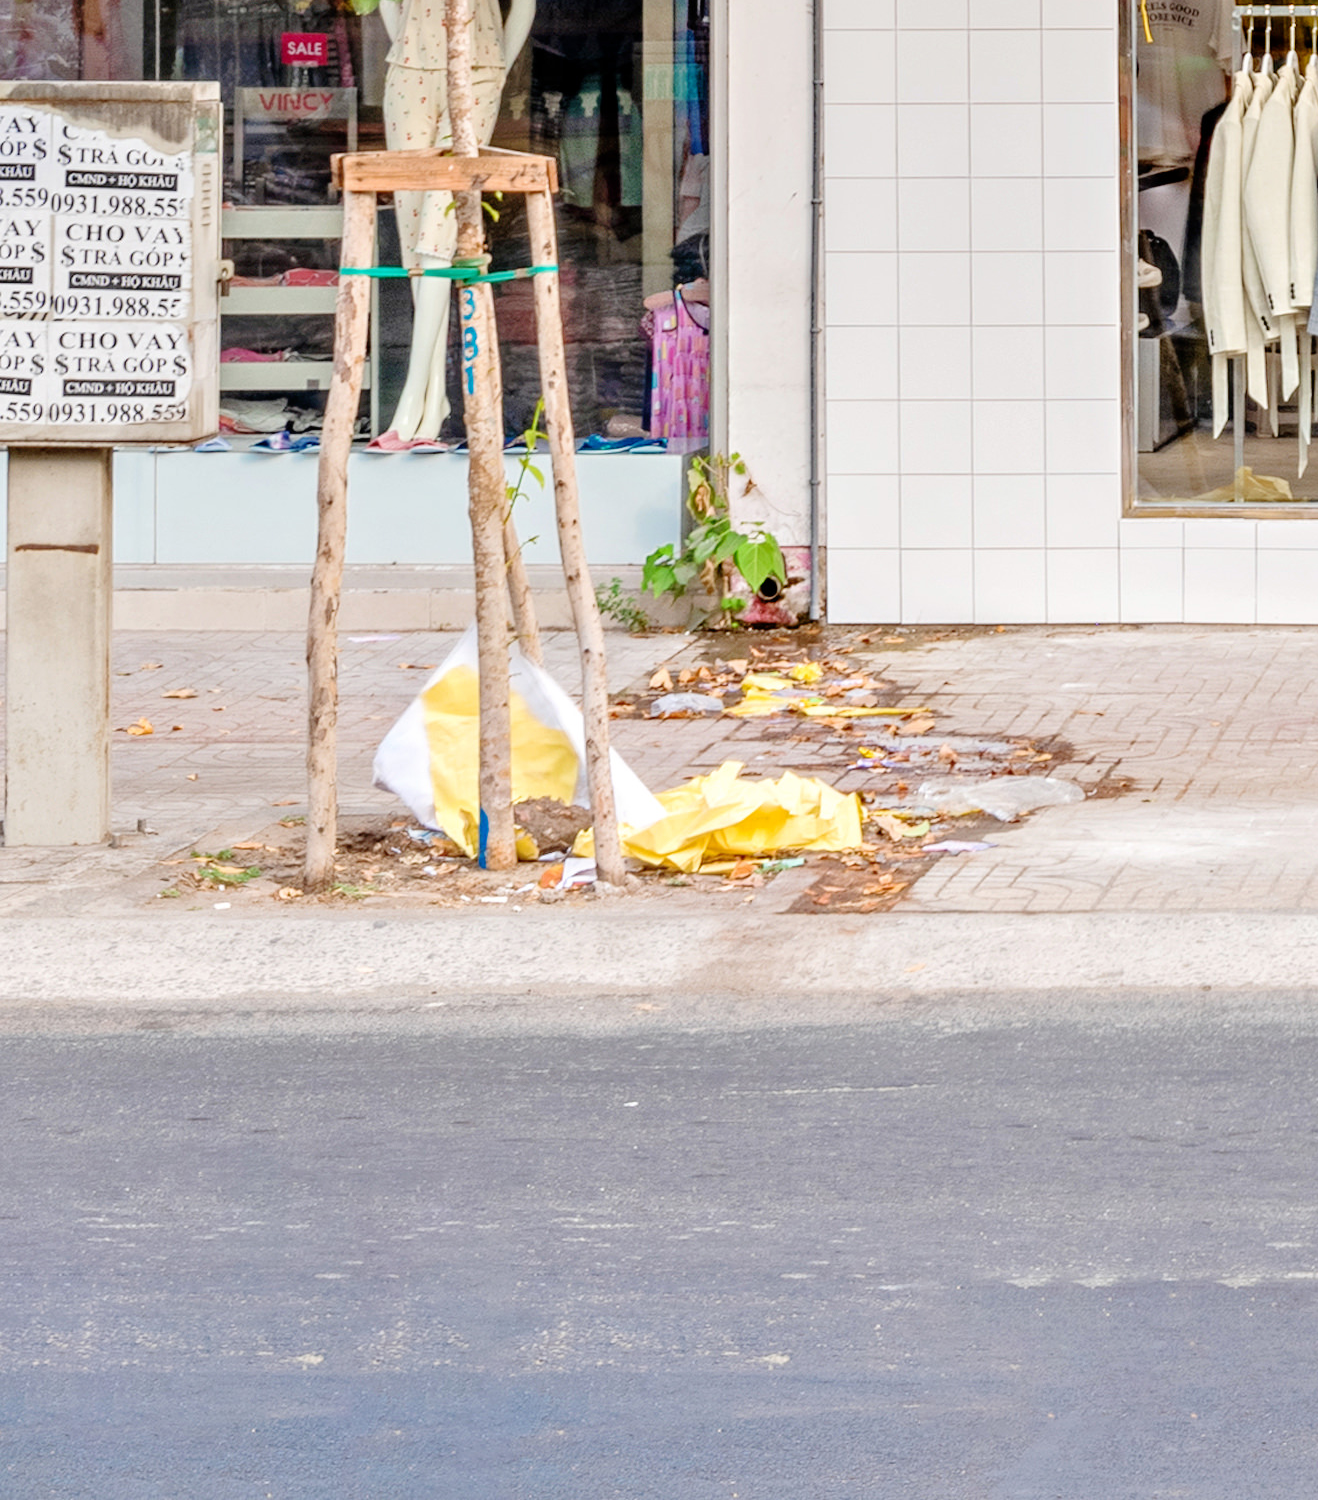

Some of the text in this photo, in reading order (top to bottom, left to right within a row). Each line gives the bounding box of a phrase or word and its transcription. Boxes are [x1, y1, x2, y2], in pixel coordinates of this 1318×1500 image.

[287, 41, 323, 56] SALE
[259, 93, 334, 113] VINCY
[0, 115, 40, 133] AY
[67, 172, 107, 186] CMND
[0, 219, 41, 237] AY
[65, 223, 185, 244] CHO VAY
[129, 246, 173, 267] GÓP
[71, 274, 109, 287] CMND
[0, 290, 46, 310] .559
[0, 330, 41, 349] AY
[59, 331, 184, 350] CHO VAY
[462, 288, 479, 395] 381
[123, 353, 168, 374] GÓP
[65, 382, 105, 395] CMND
[49, 402, 187, 423] 0931.988.559
